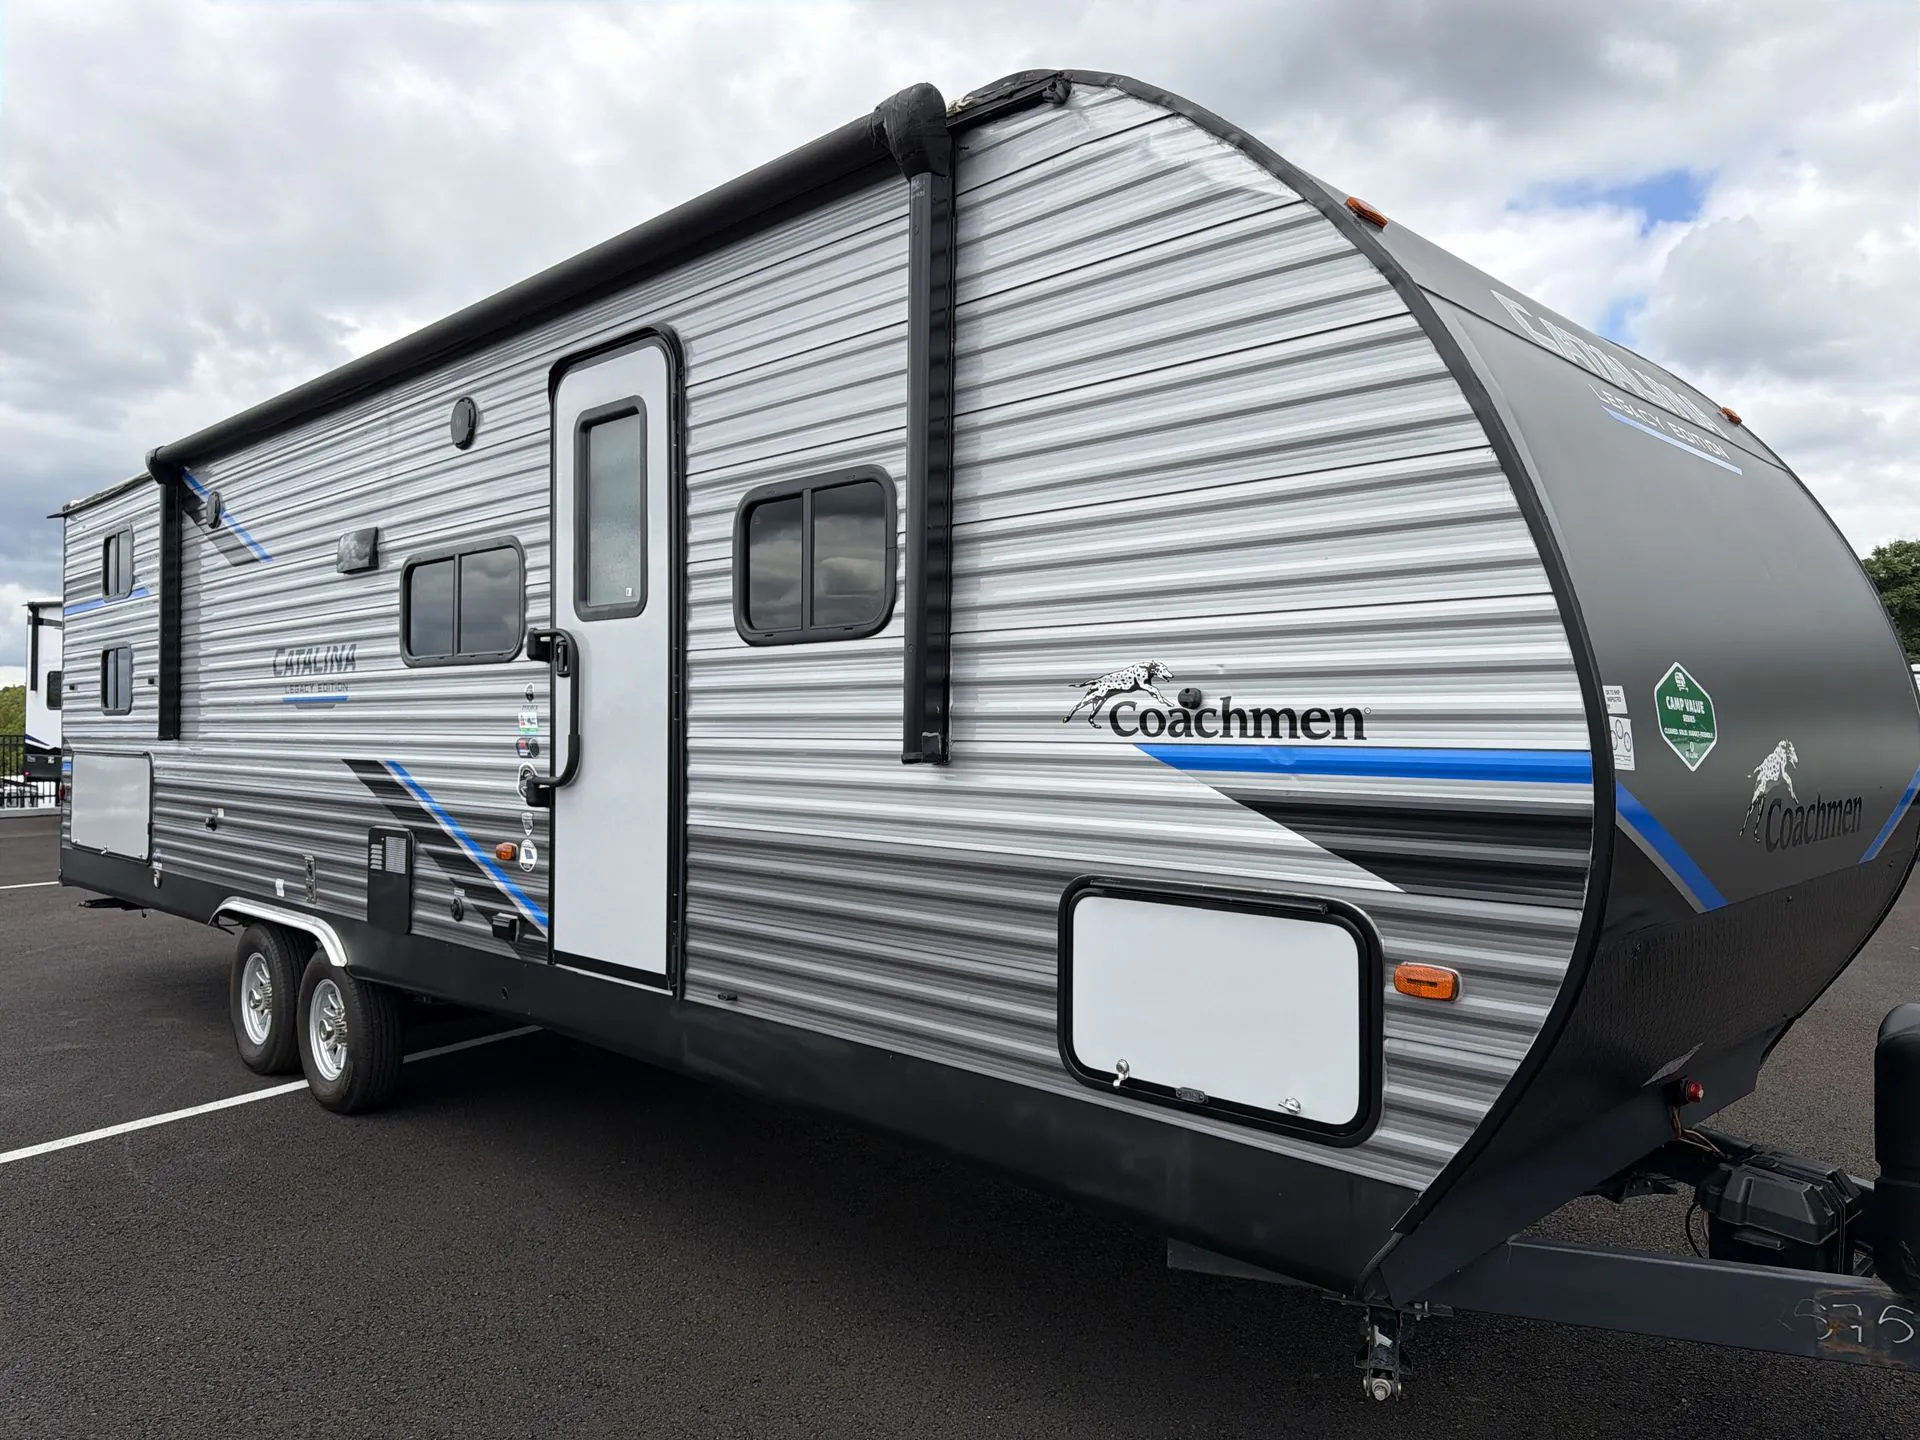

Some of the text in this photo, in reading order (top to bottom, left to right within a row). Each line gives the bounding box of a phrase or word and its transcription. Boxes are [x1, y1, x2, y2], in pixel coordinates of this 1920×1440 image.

[1588, 383, 1731, 460] LEGACY EDITION
[273, 643, 357, 677] CATALINA
[284, 682, 349, 694] LEGACY EDITION
[1665, 695, 1705, 714] CAMP VALUE
[1109, 696, 1367, 741] Coachmen
[1765, 795, 1862, 852] Coachmen
